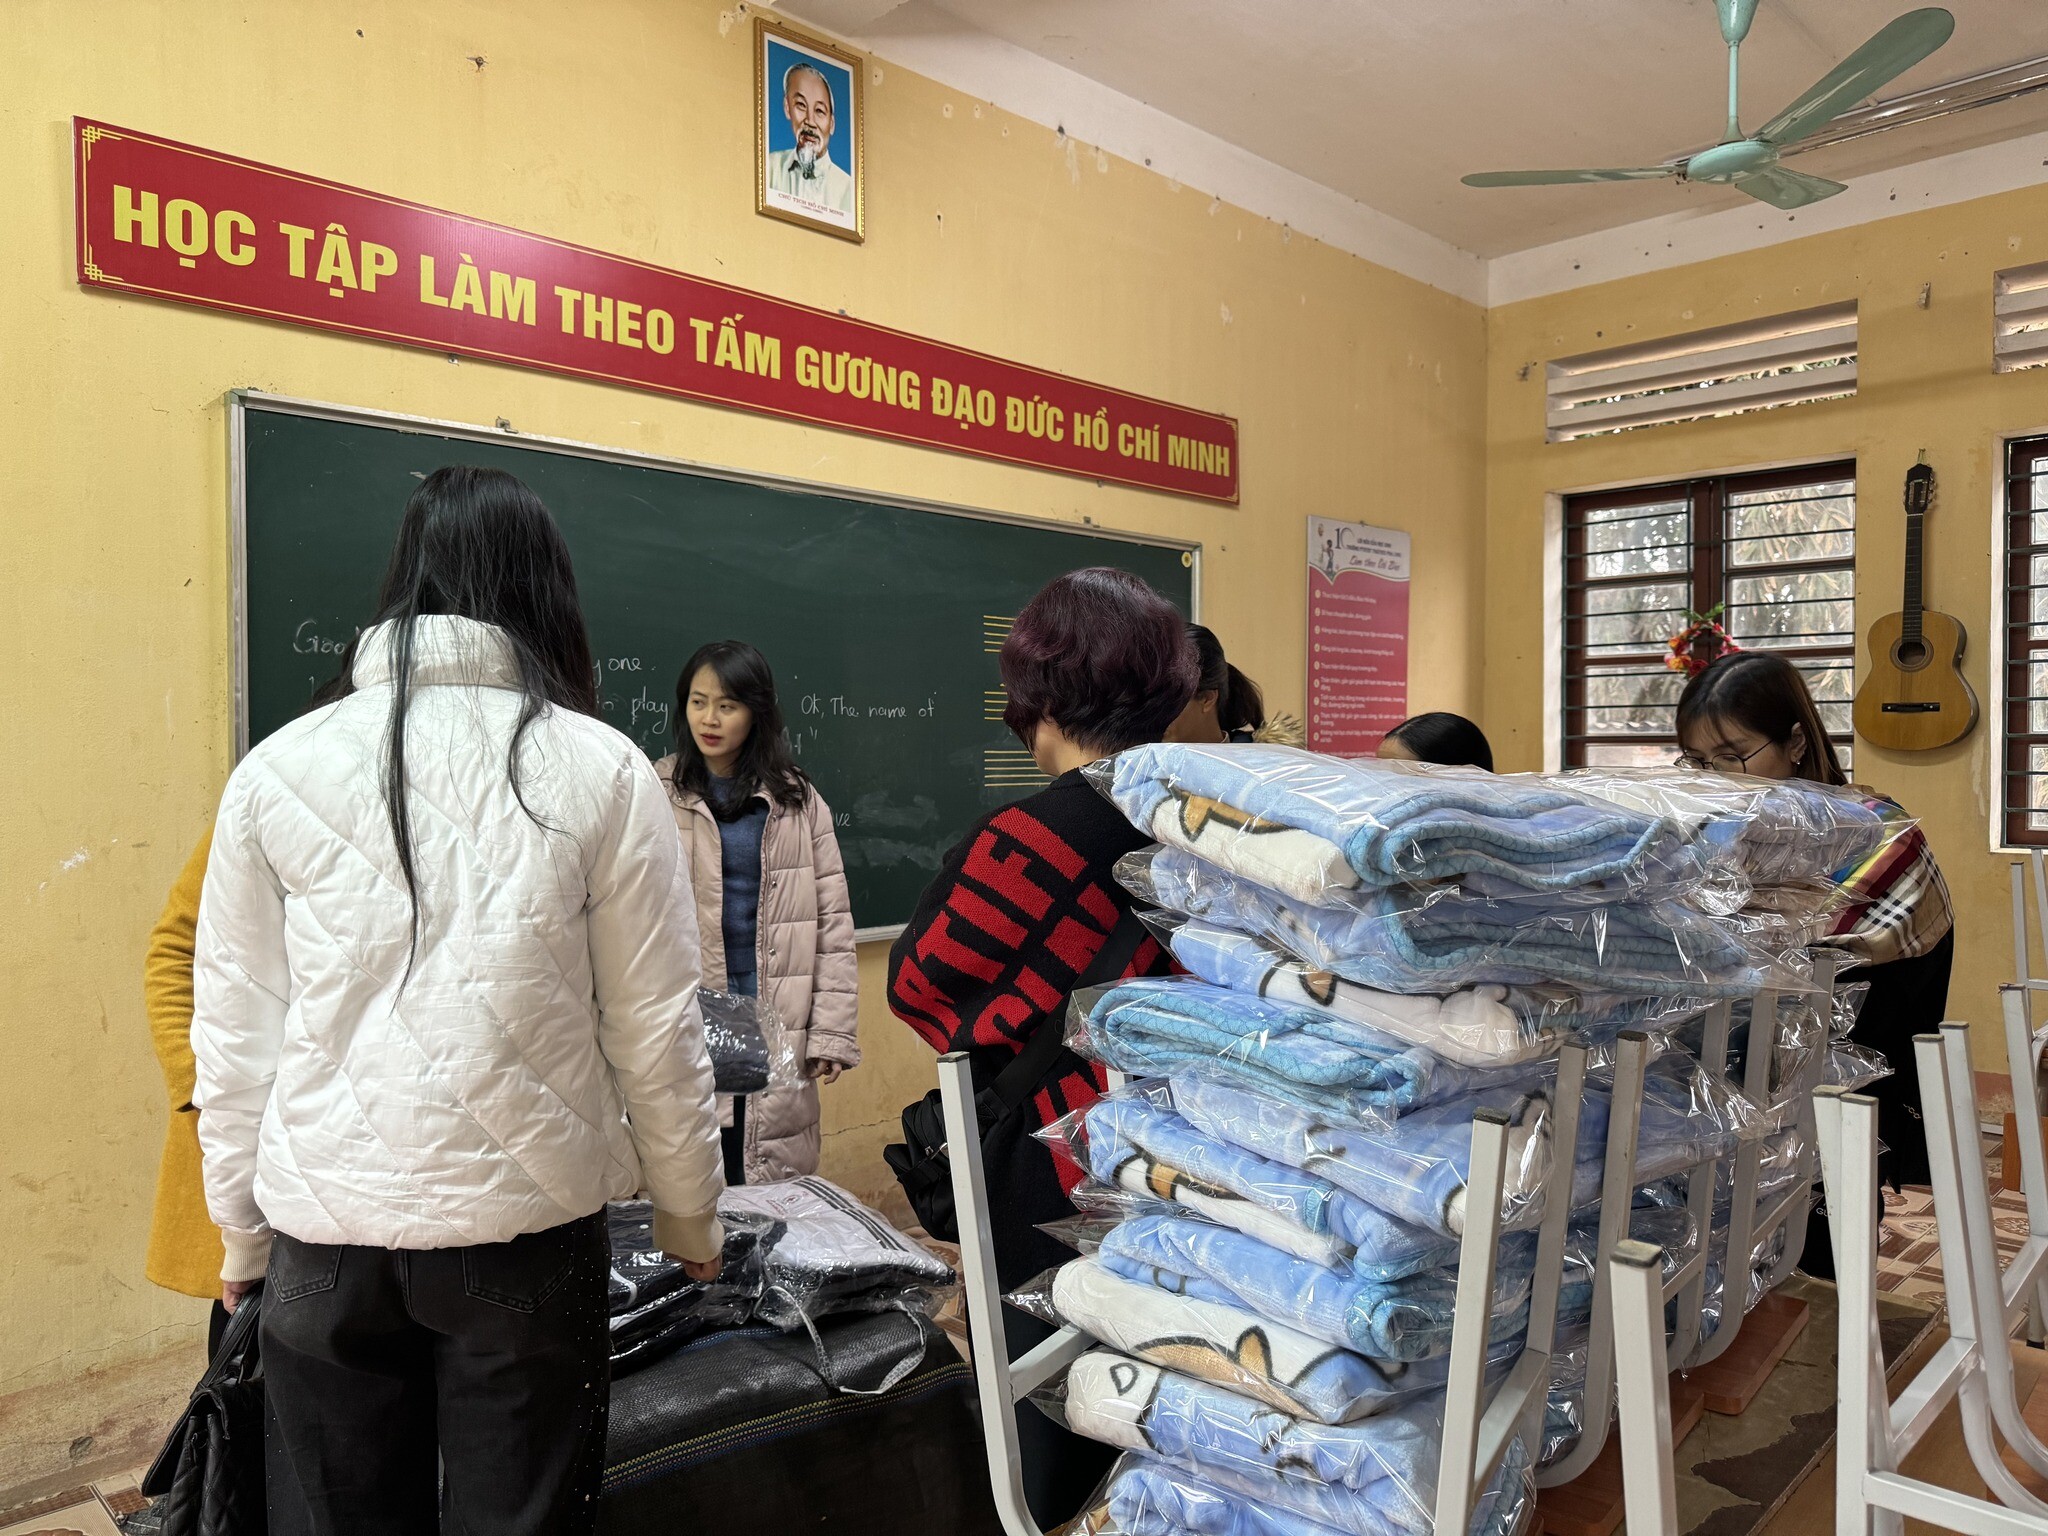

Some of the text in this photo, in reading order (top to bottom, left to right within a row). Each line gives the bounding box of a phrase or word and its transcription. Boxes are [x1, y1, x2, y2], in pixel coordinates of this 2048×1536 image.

[114, 185, 1231, 477] HỌC TẬP LÀM THEO TẤM GƯƠNG ĐẠO ĐỨC HỒ CHÍ MINH
[292, 618, 361, 656] Goo
[631, 686, 669, 735] play
[868, 706, 908, 719] name
[918, 697, 936, 718] of
